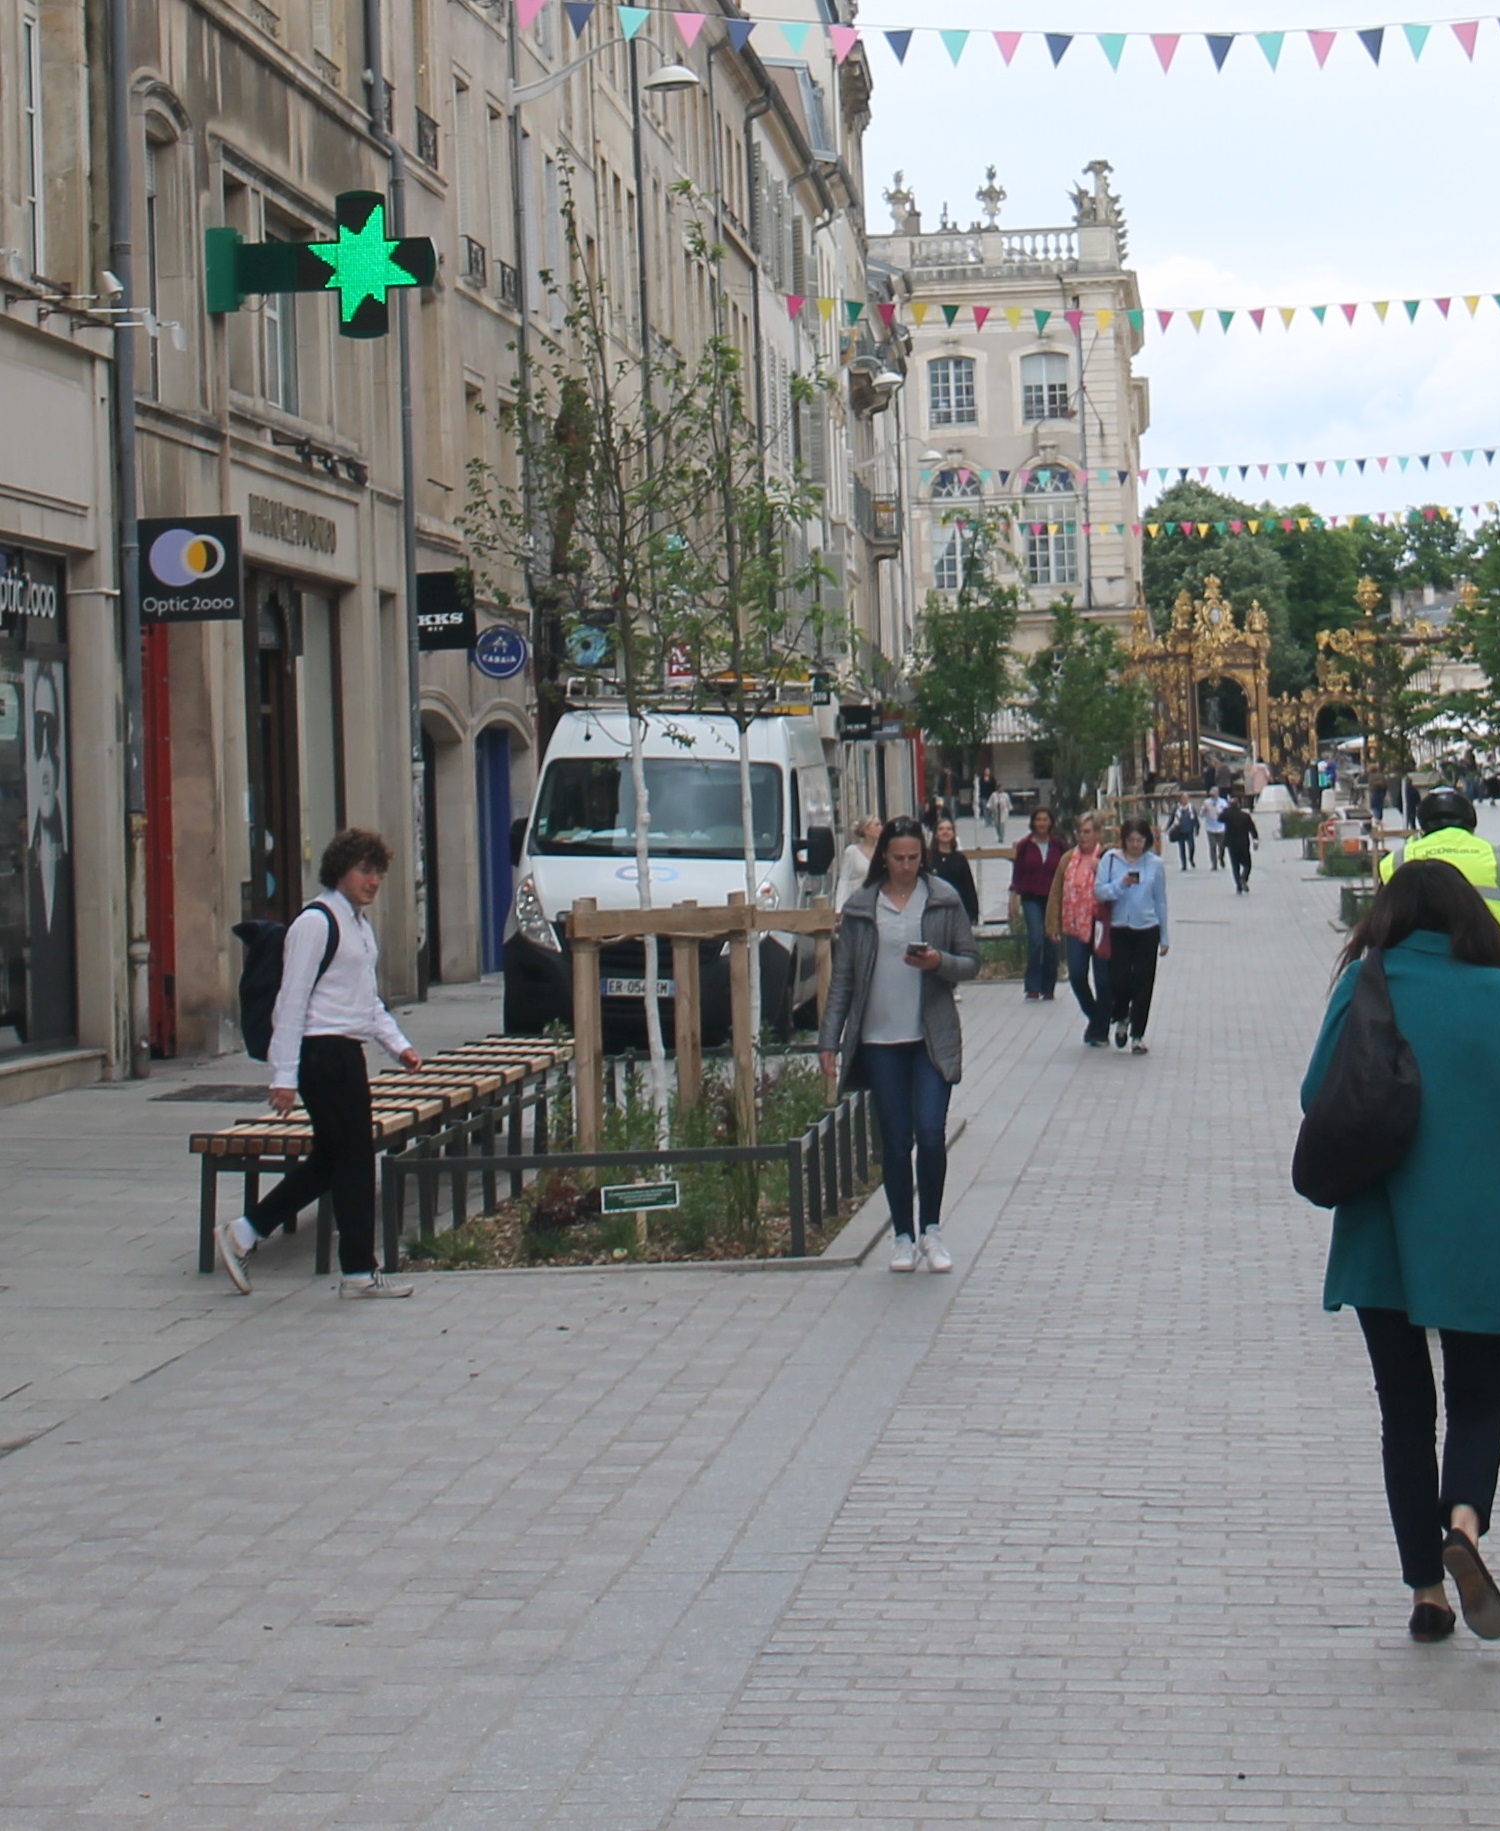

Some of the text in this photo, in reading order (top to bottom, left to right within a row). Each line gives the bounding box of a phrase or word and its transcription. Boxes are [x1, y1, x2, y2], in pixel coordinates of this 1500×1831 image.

[22, 572, 56, 619] 2000
[142, 596, 235, 616] Optic 2000
